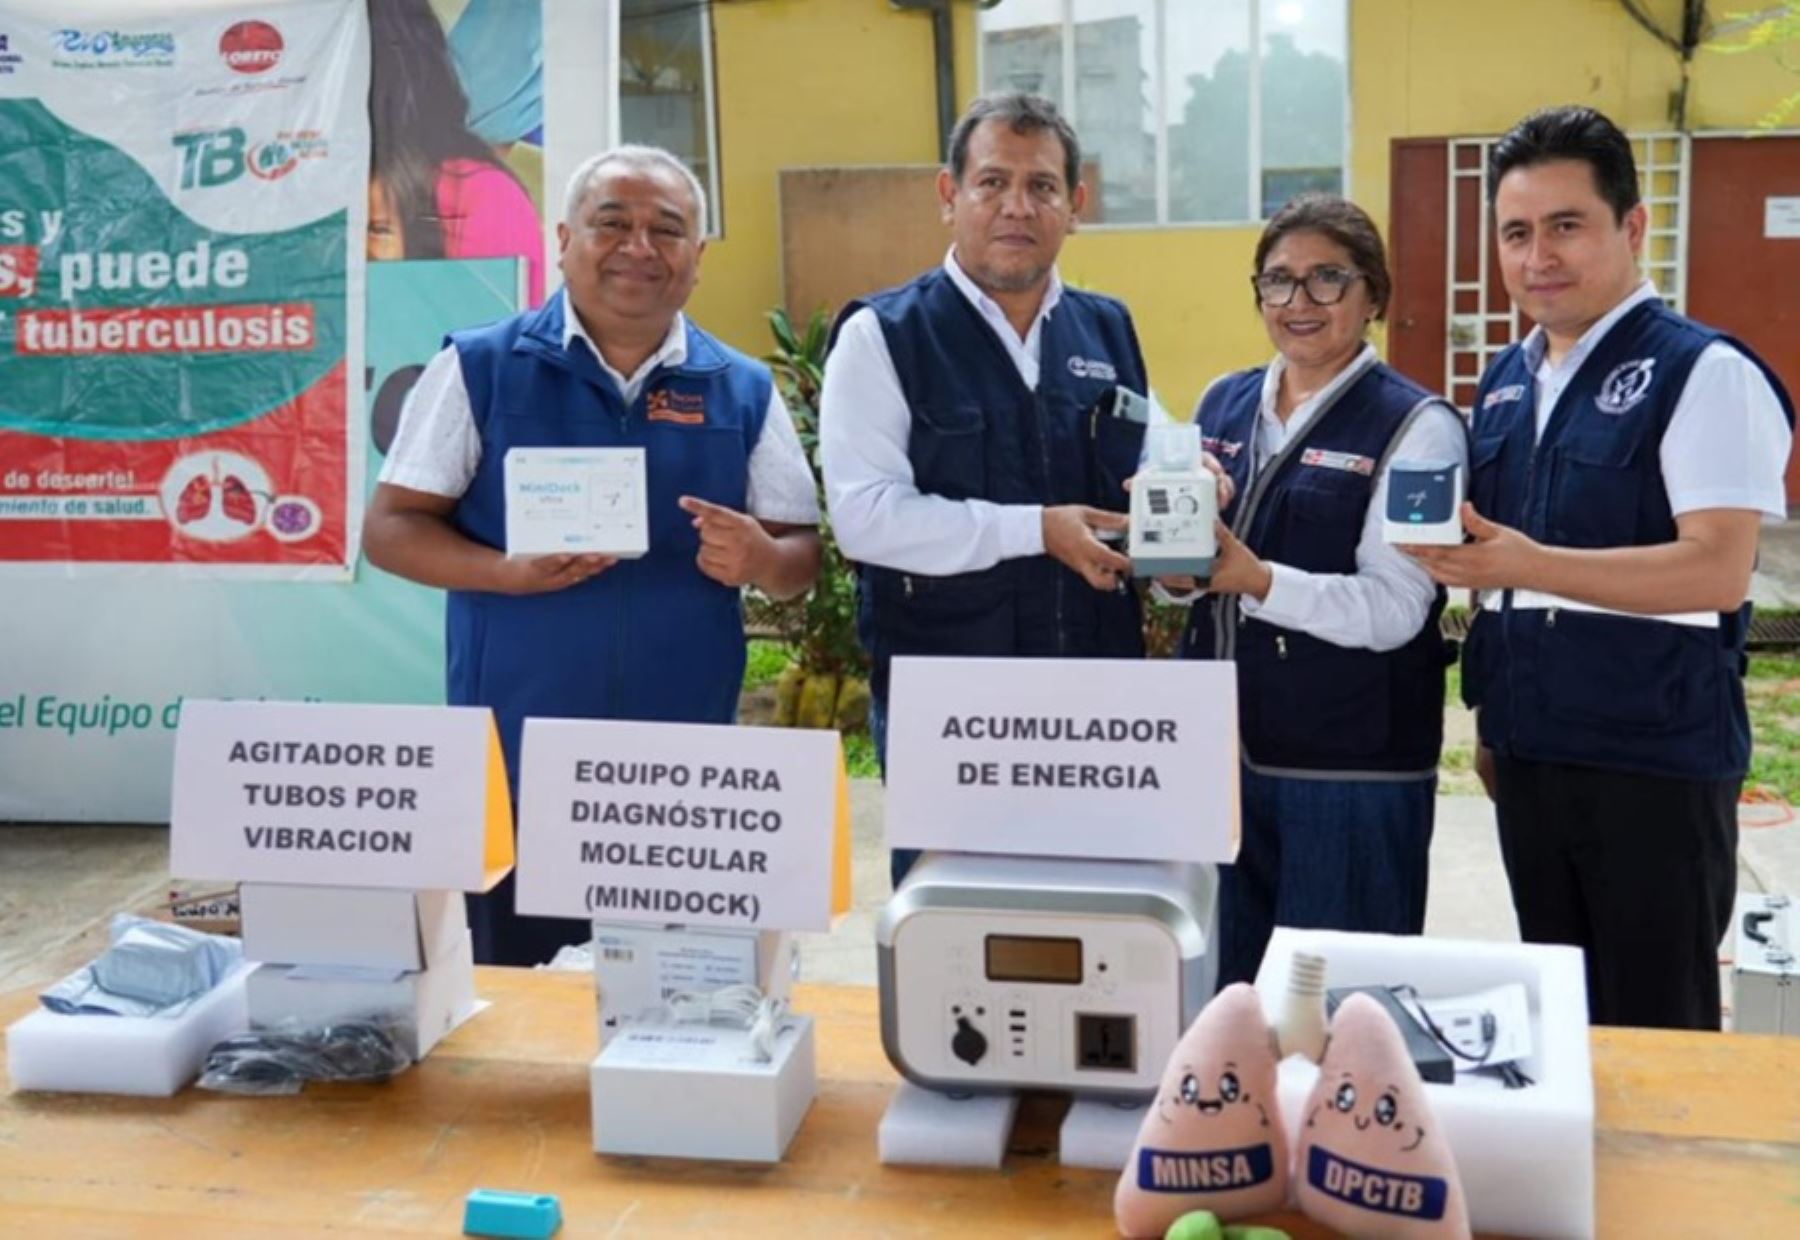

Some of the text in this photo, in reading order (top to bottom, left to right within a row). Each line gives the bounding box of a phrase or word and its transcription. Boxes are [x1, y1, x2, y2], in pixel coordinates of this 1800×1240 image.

[172, 127, 247, 190] TB
[0, 210, 63, 246] s y
[60, 241, 250, 300] puede
[24, 310, 310, 350] tuberculosis
[4, 470, 30, 490] de
[64, 499, 87, 515] de
[36, 694, 152, 736] Equipo
[162, 696, 184, 730] d
[941, 716, 1178, 743] ACUMULADOR
[228, 741, 435, 768] AGITADOR DE
[575, 760, 783, 792] EQUIPO PARA
[957, 762, 1161, 790] DE ENERGIA
[243, 783, 418, 811] TUBOS POR
[571, 798, 783, 833] DIAGNÓSTICO
[244, 827, 413, 853] VIBRACION
[580, 841, 768, 874] MOLECULAR
[585, 884, 761, 923] (MINIDOCK)
[1151, 1154, 1254, 1187] MINSA
[1323, 1160, 1425, 1212] DPCTB
